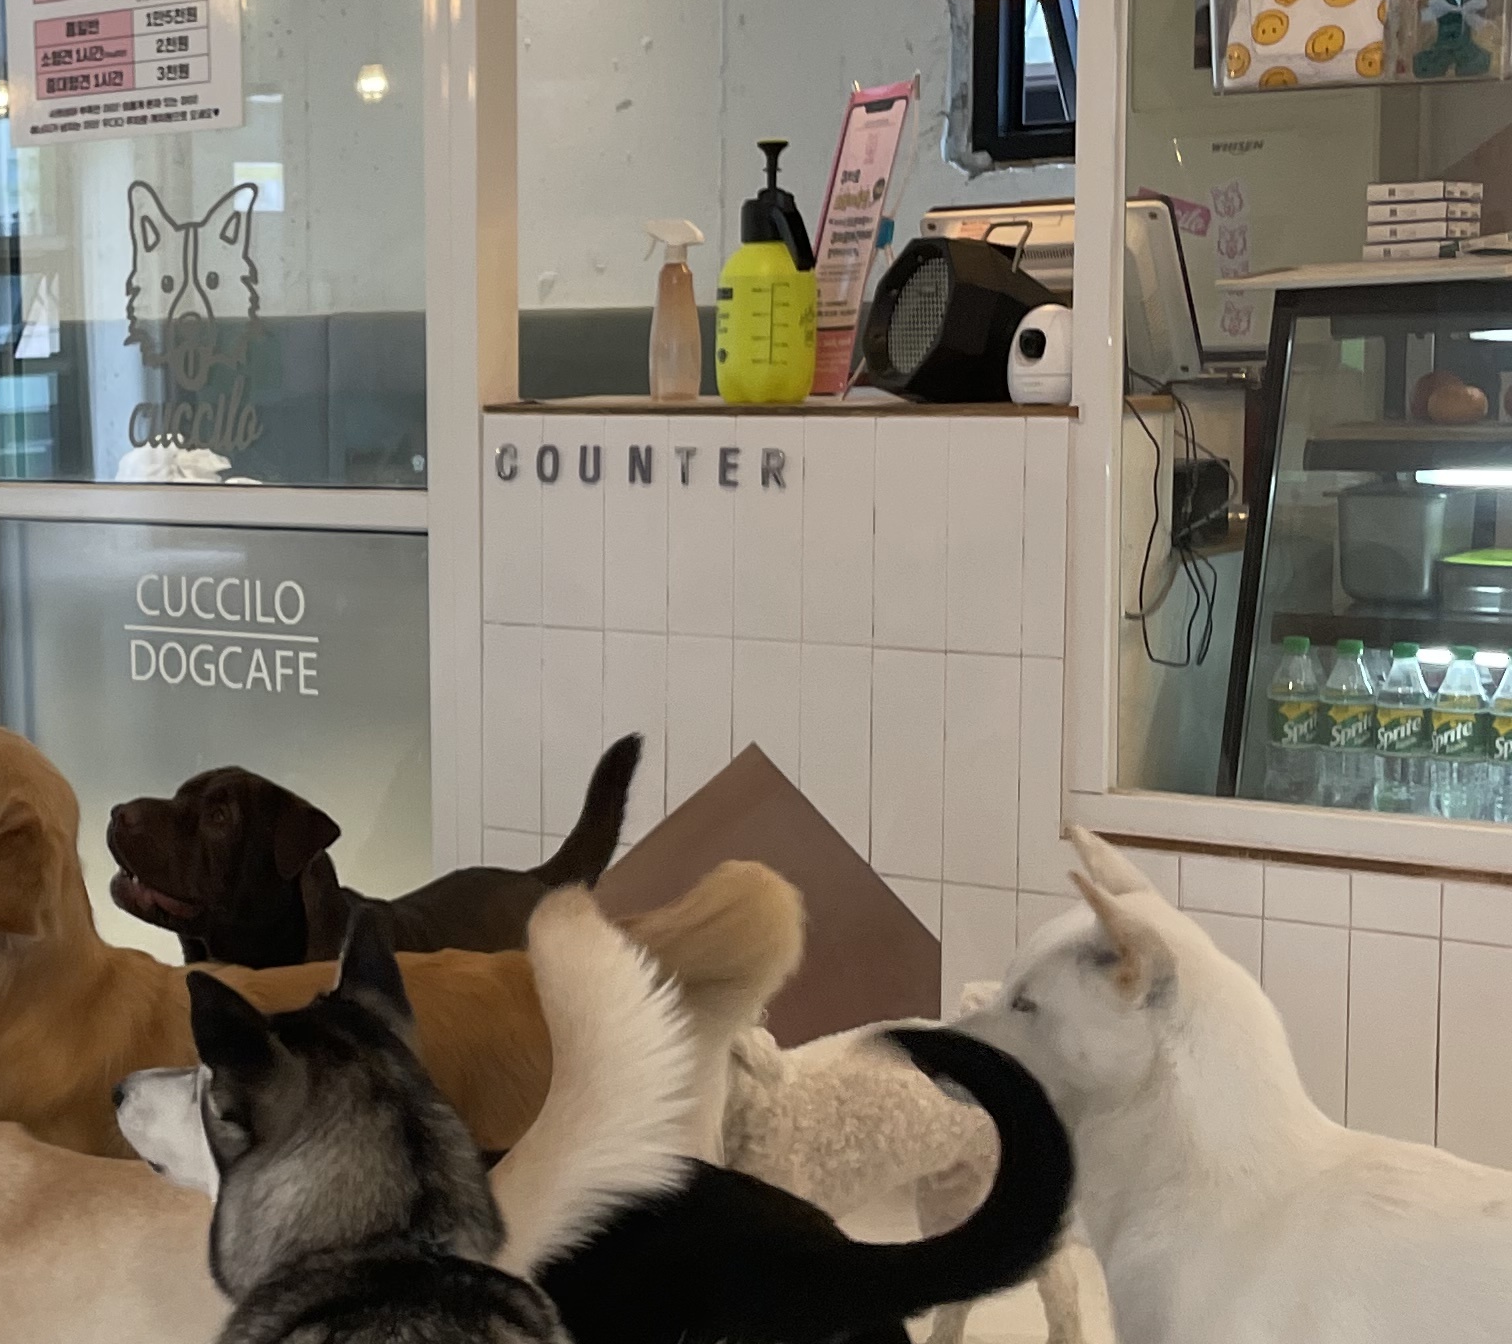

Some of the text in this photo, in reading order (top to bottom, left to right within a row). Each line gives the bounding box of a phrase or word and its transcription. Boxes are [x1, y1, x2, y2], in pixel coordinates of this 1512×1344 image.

[145, 6, 197, 28] 1만5천원
[155, 35, 189, 54] 2천원
[93, 71, 124, 89] 1시간
[156, 63, 189, 81] 3천원
[129, 374, 264, 452] cuccilo
[494, 443, 787, 489] COUNTER
[136, 573, 306, 626] CUCCILO
[130, 639, 319, 696] DOGCAFE
[1377, 716, 1422, 751] Sprite
